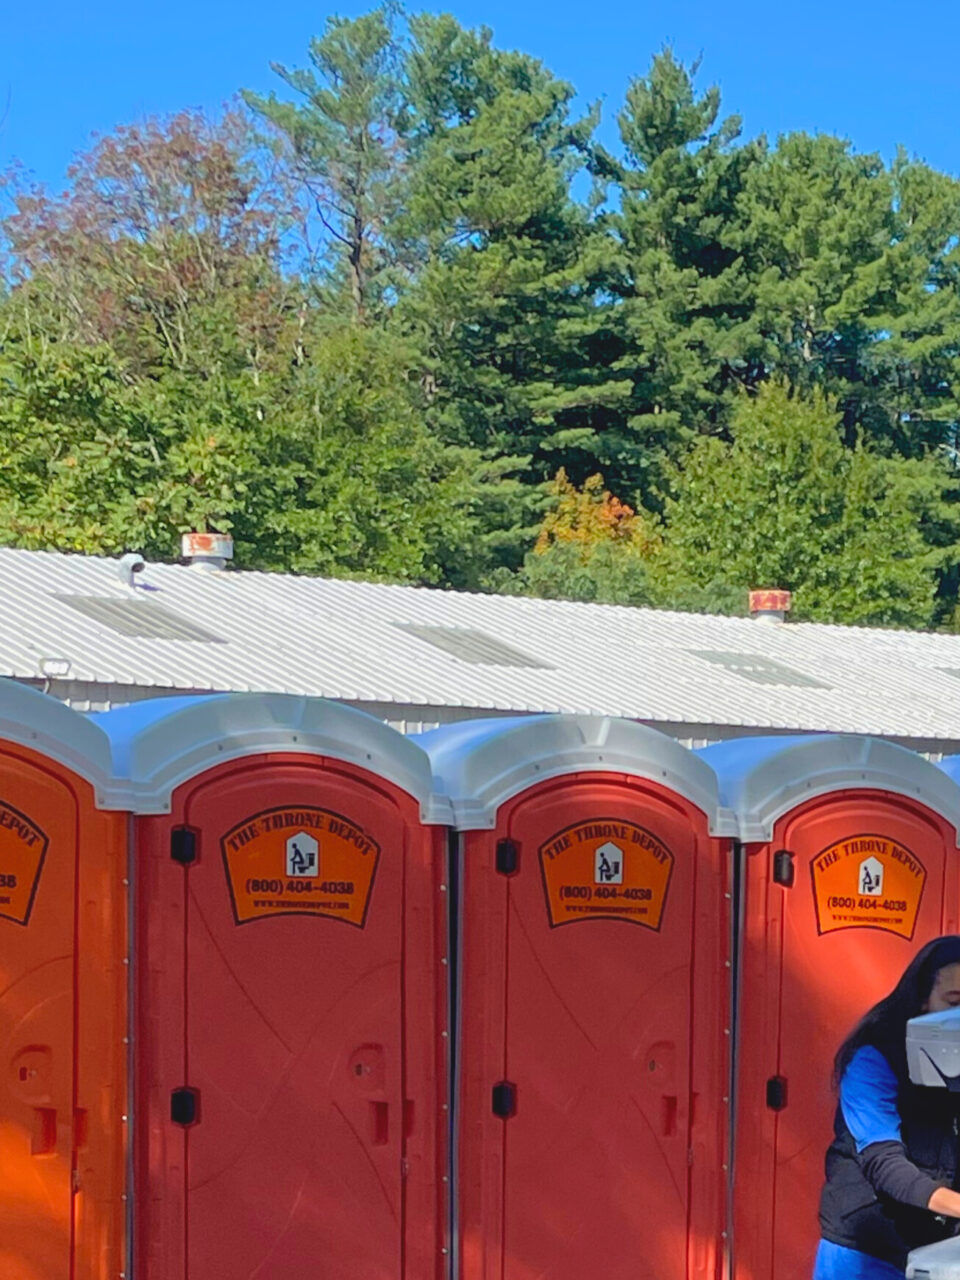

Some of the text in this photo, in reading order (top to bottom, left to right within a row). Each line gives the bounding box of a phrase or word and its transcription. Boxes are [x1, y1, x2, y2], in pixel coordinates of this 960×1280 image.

[227, 812, 373, 855] THE THRONE DEPOT
[544, 824, 669, 865] THE THRONE DEPOT
[816, 840, 923, 878] THE THRONE DEPOT
[246, 878, 354, 895] (800) 404-4038
[560, 886, 652, 901] (800) 404-4038
[827, 896, 907, 912] (800) 404-4038
